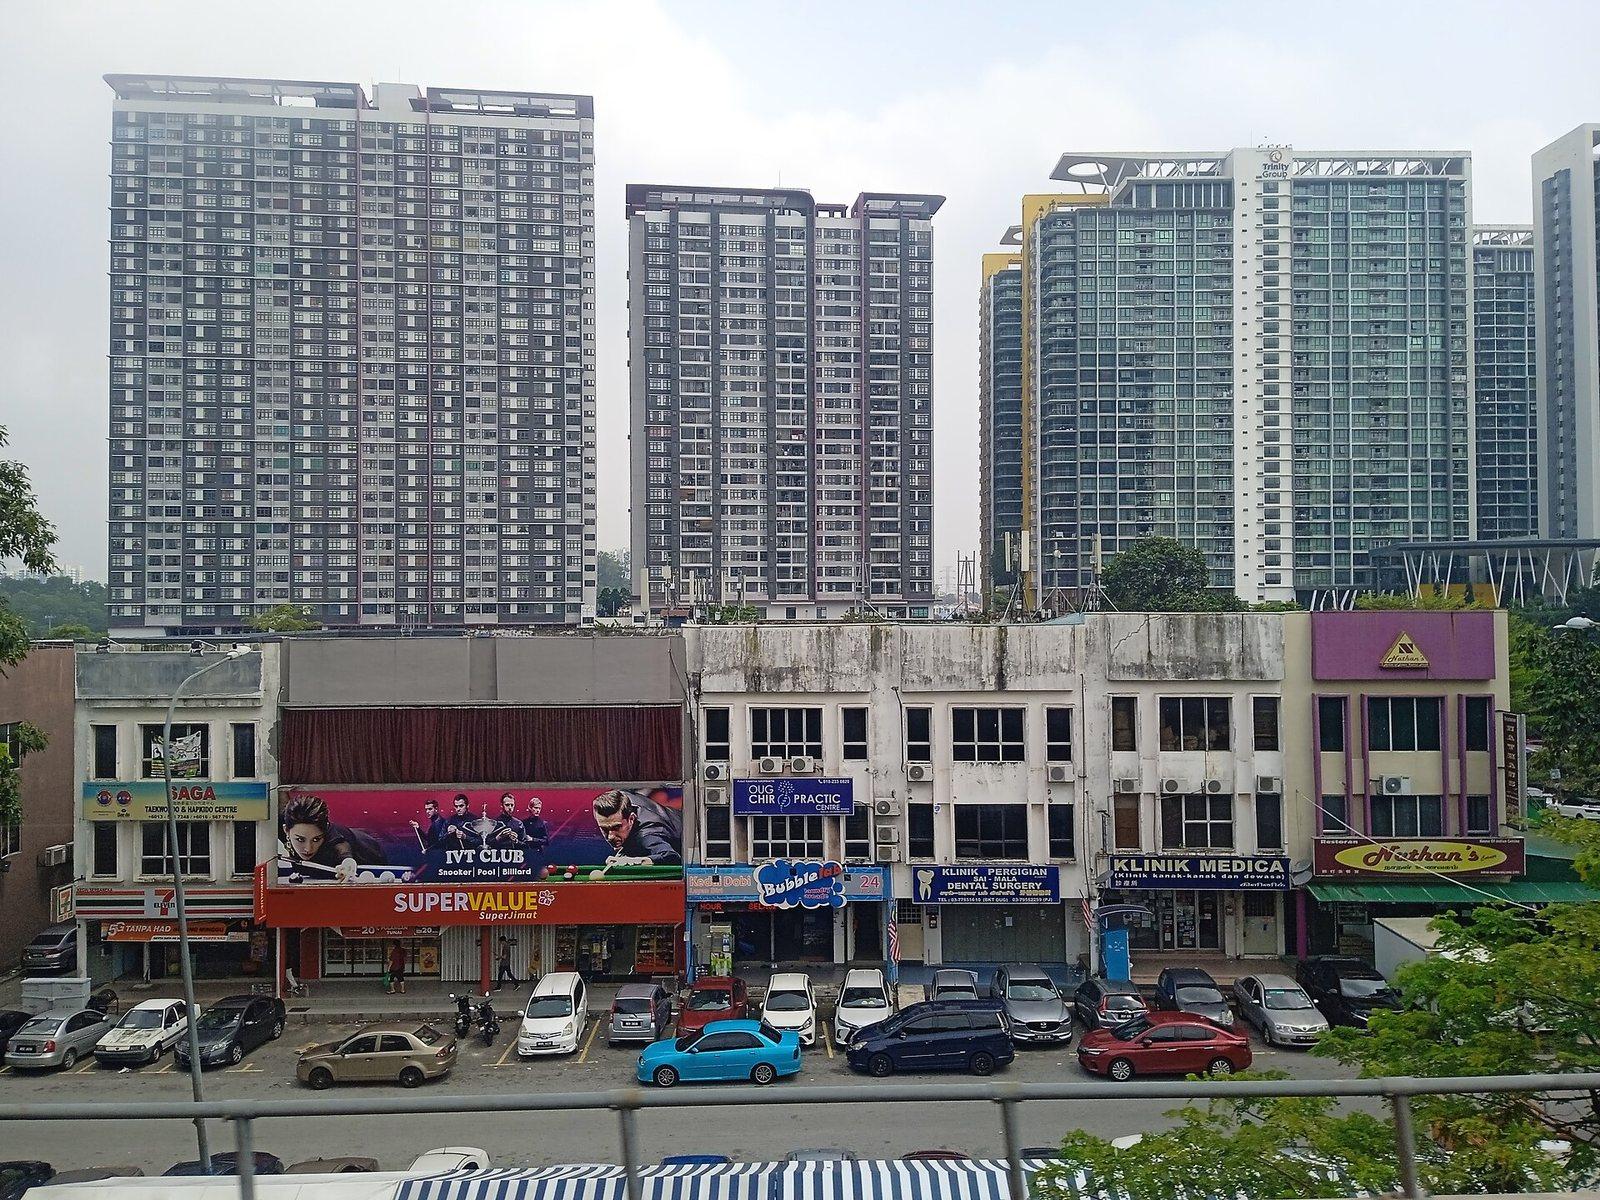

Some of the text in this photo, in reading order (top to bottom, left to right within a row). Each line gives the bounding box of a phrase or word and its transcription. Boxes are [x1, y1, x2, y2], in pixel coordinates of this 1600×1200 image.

[1262, 163, 1289, 171] Trinity
[171, 786, 216, 800] SAGA
[749, 785, 774, 794] OUG
[749, 794, 841, 804] CHIR PRACTIC
[446, 849, 525, 864] IVT CLUB
[1362, 845, 1479, 867] Nathan's
[1114, 859, 1285, 872] KLINIK MEDICA
[438, 868, 471, 876] Snooker
[477, 868, 496, 876] Pool
[942, 868, 1047, 876] KLINIK PERGIGIAN
[723, 875, 752, 887] Dobi
[763, 872, 819, 897] Bubble
[860, 874, 880, 888] 24
[947, 882, 1042, 890] DENTAL SURGERY
[154, 887, 175, 915] 7
[394, 891, 538, 912] SUPERVALUE
[479, 910, 537, 921] SuperJimat
